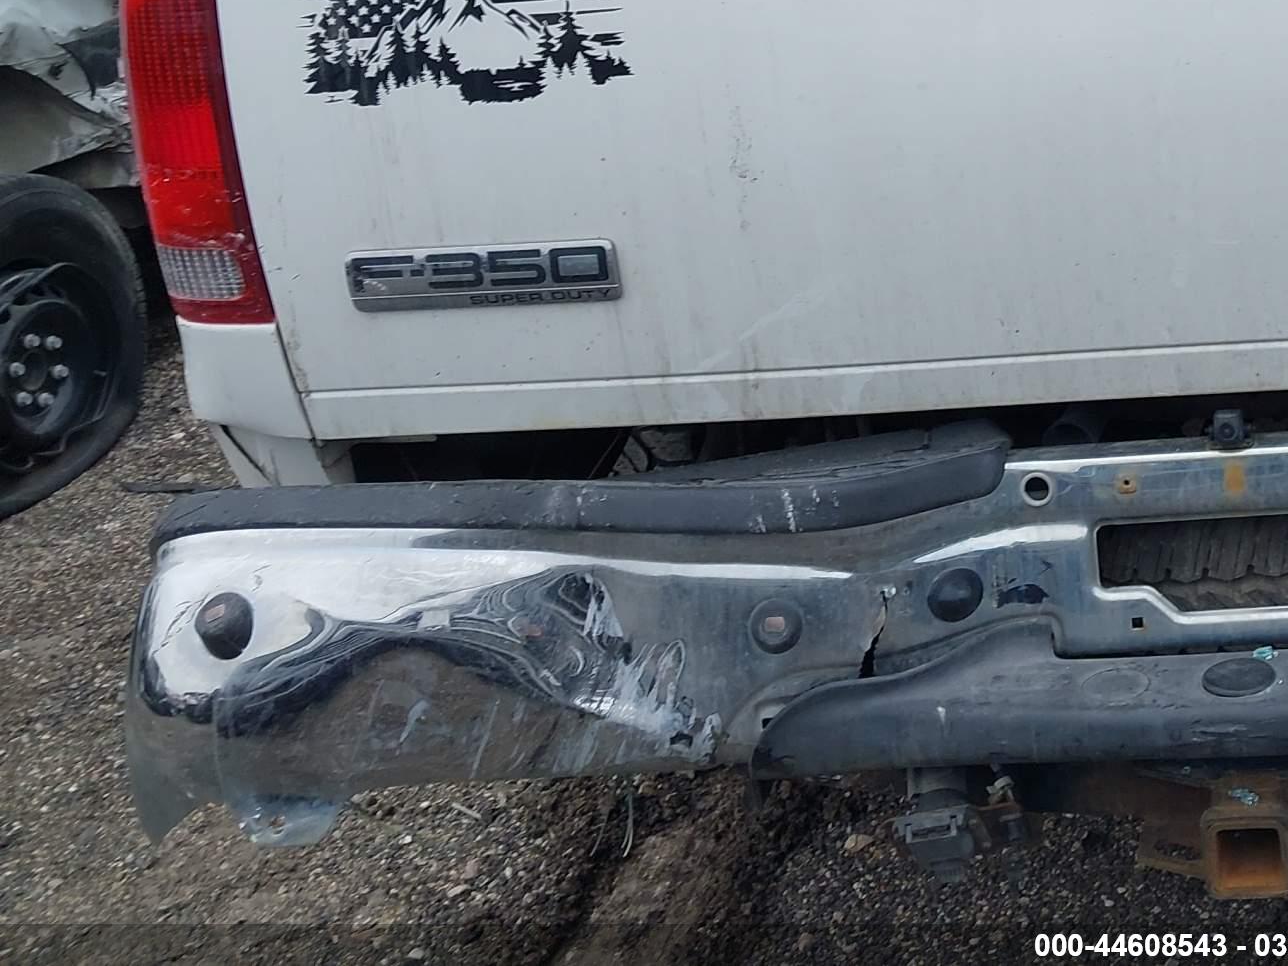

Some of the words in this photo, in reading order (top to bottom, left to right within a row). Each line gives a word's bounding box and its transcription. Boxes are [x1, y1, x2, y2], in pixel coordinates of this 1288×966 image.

[350, 245, 609, 293] F-350
[469, 292, 545, 305] SUPER
[551, 287, 612, 301] DUTY
